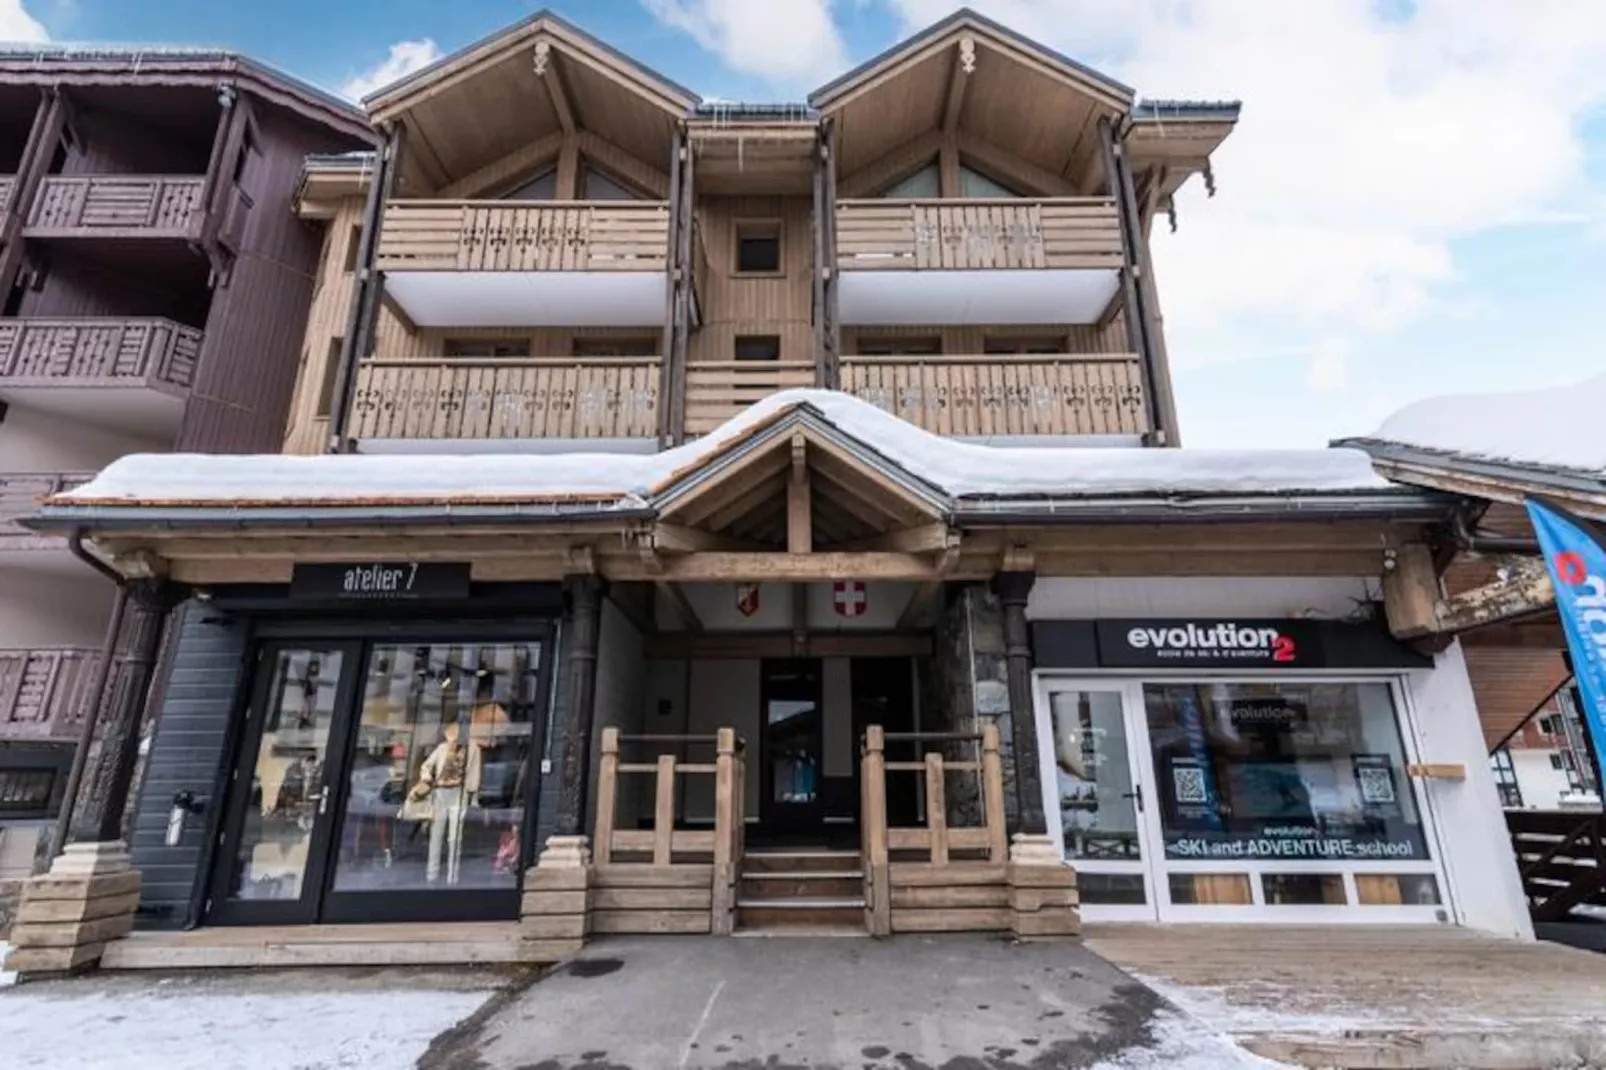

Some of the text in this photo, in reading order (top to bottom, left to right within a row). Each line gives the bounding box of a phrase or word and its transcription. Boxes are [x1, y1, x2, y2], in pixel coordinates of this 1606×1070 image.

[343, 562, 418, 591] atelier 7
[1177, 839, 1413, 856] SKI and ADVENTURE school
